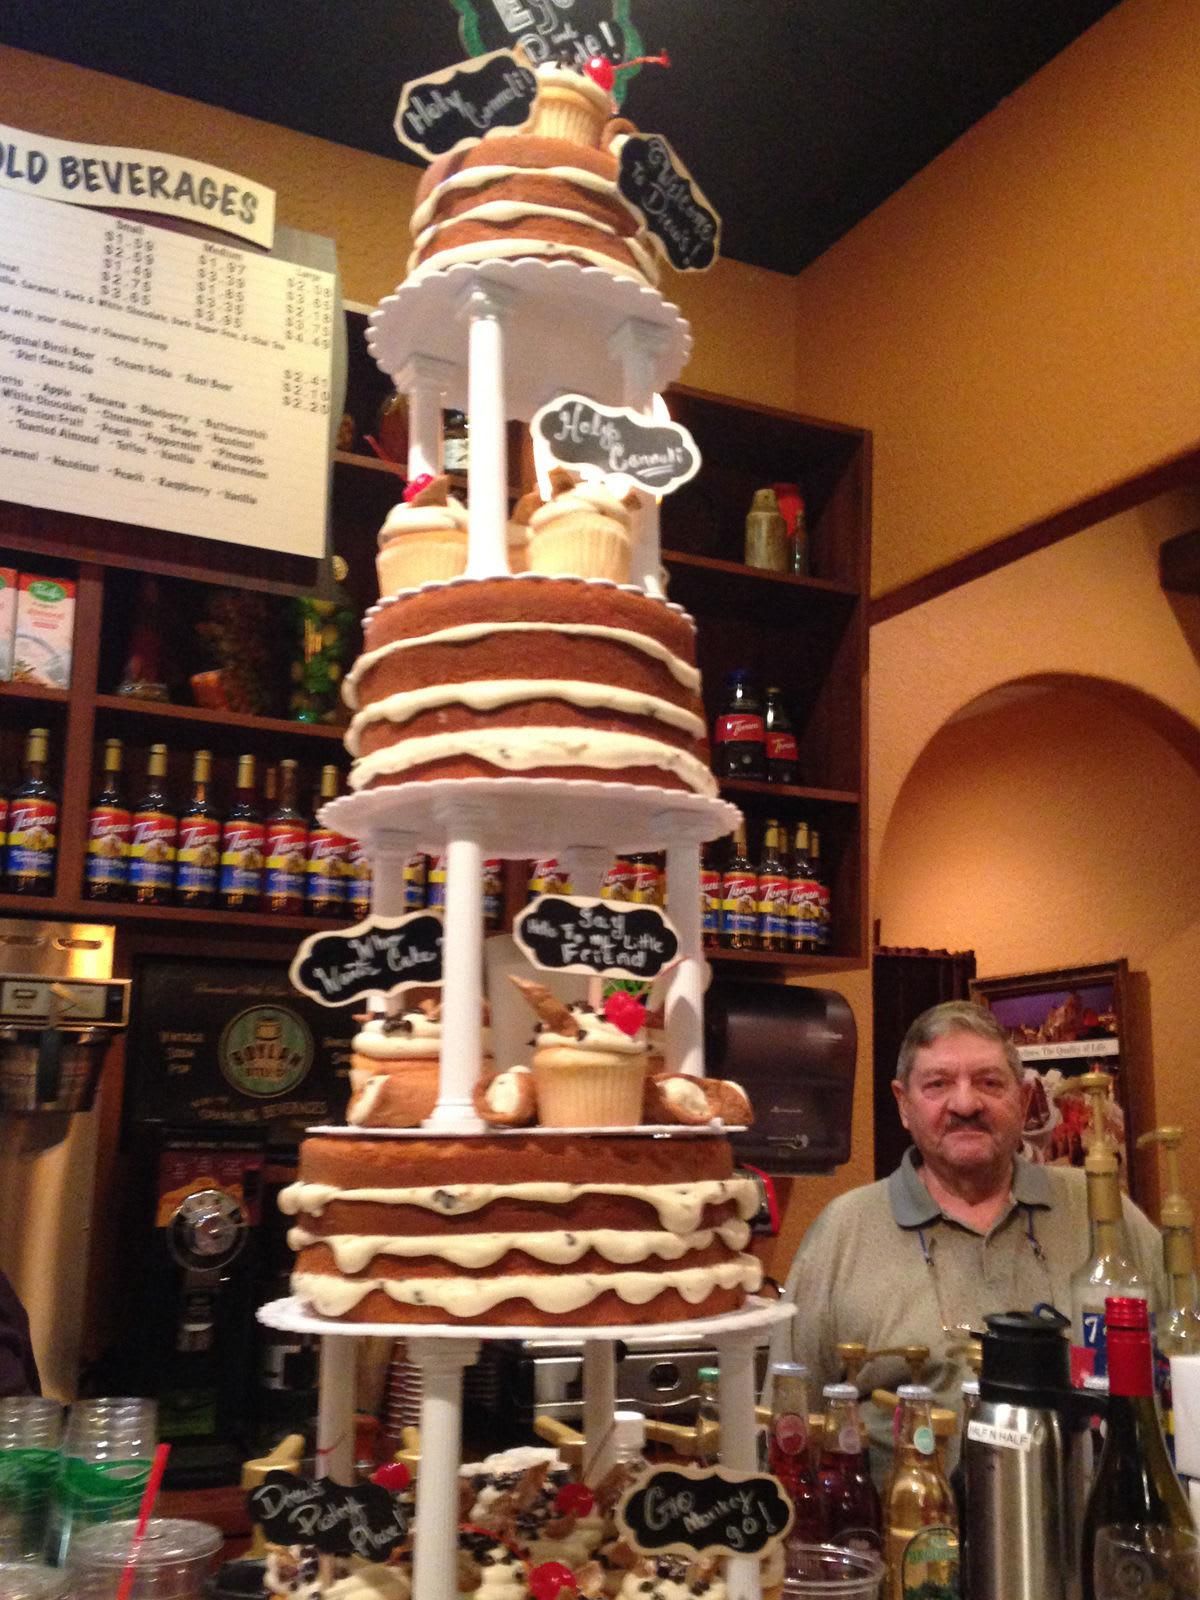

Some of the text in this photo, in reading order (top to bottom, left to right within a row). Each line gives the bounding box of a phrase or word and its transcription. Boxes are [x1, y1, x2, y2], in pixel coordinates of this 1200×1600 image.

[60, 155, 259, 224] BEVERAGES
[553, 402, 622, 451] Holy
[578, 908, 627, 940] Say
